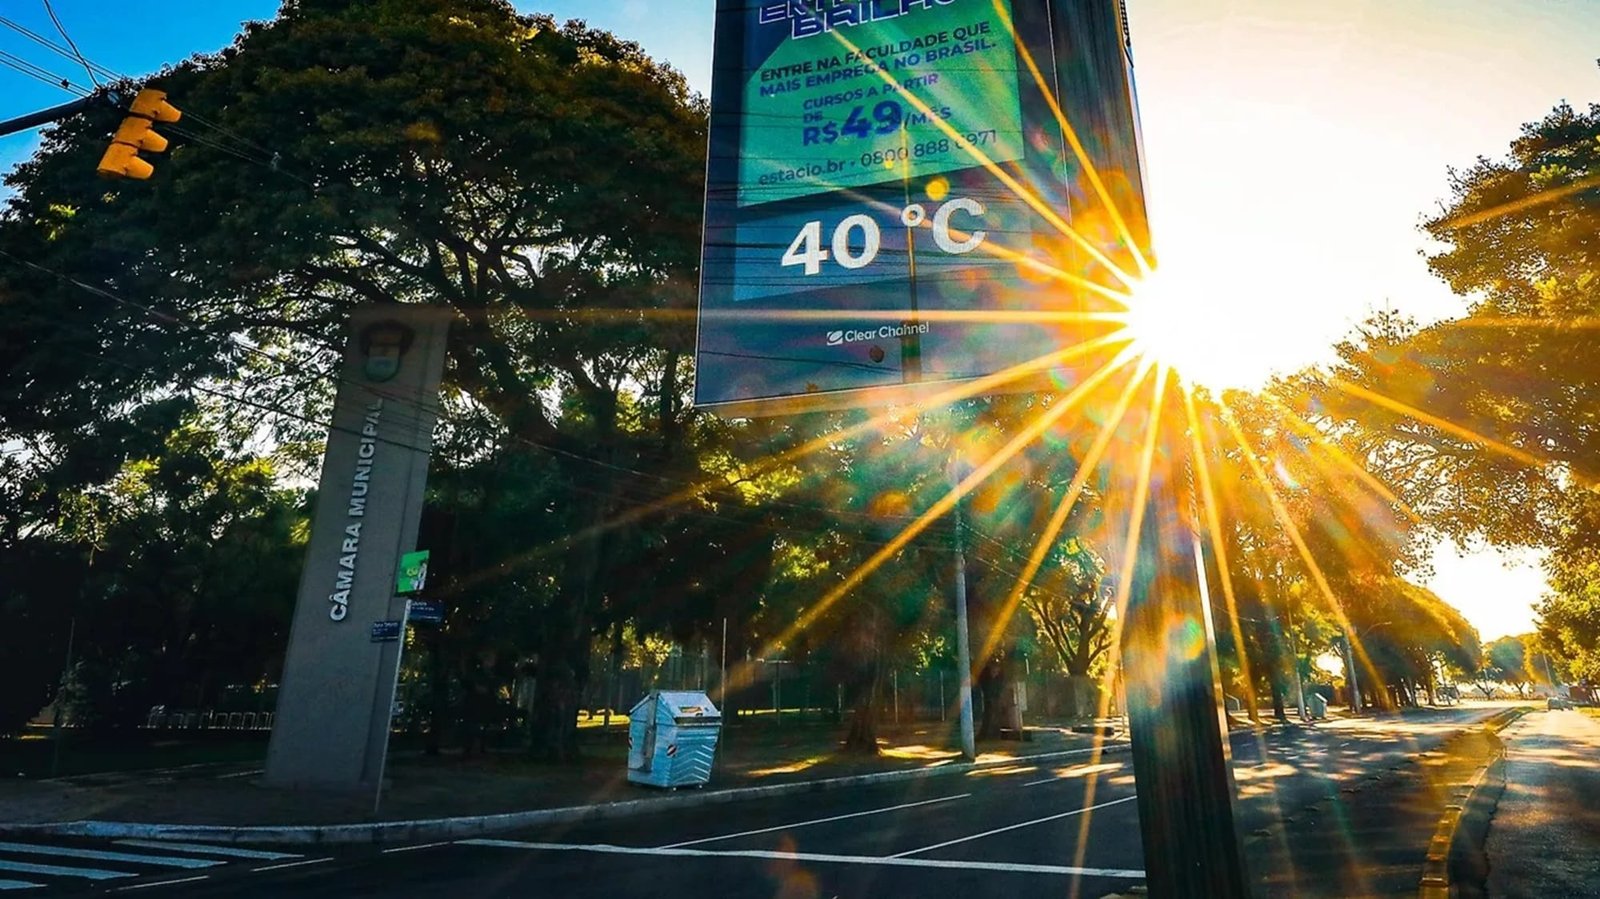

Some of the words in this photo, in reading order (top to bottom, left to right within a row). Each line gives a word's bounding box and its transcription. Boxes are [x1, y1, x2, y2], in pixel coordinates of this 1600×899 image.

[760, 79, 801, 97] MAIS
[805, 61, 889, 87] EMPREGA
[894, 53, 920, 69] NO
[925, 37, 997, 62] BRASIL.
[761, 61, 813, 82] ENTRE
[816, 56, 841, 71] NA
[845, 31, 949, 65] FACULDADE
[953, 21, 991, 41] QUE
[803, 88, 863, 110] CURSOS
[867, 86, 878, 98] A
[803, 111, 823, 124] DE
[758, 160, 846, 185] estacio.br
[861, 147, 908, 167] 0800
[914, 138, 949, 157] 888
[781, 214, 881, 276] 40
[901, 197, 987, 254] °C
[844, 329, 877, 343] Clear
[878, 321, 930, 338] Channel
[328, 522, 362, 622] CÂMARA
[348, 398, 384, 518] MUNICIPAL
